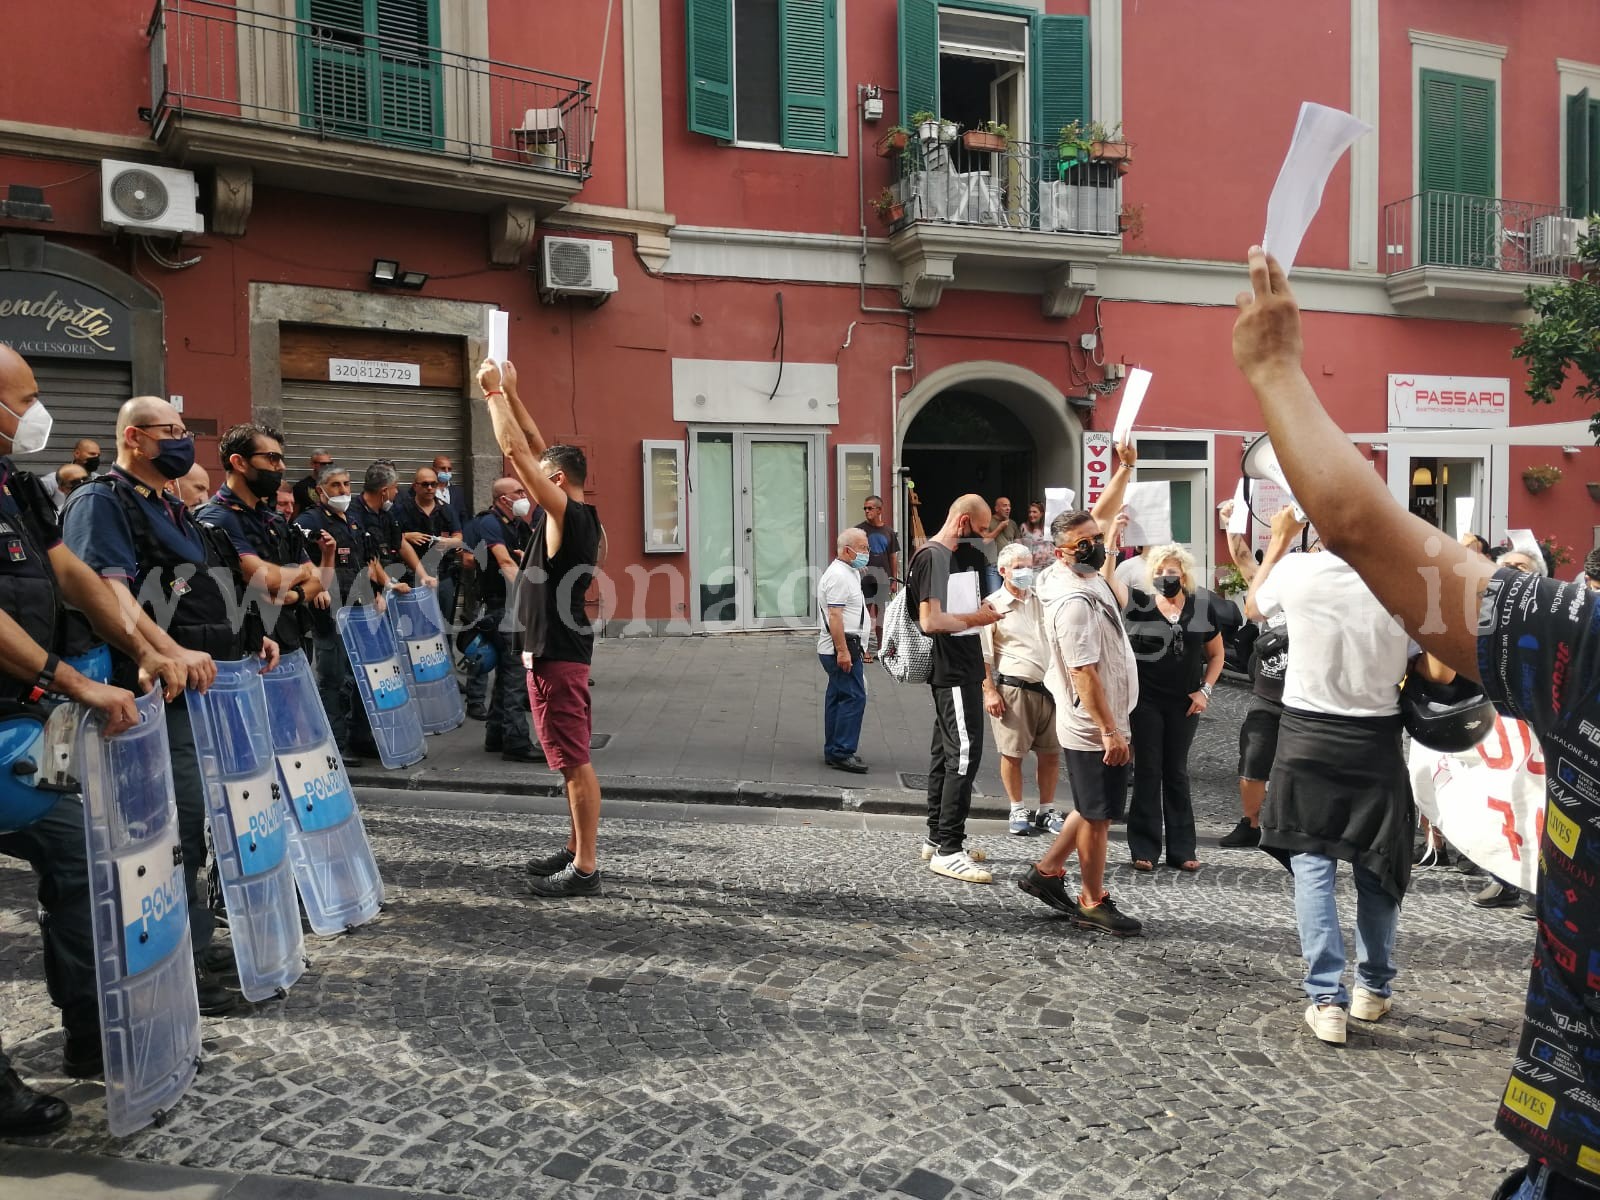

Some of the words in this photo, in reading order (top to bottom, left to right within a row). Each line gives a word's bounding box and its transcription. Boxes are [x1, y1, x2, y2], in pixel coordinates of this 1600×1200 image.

[19, 341, 96, 355] ACCESSORIES
[1416, 390, 1505, 406] PASSARO
[1550, 811, 1573, 844] LIVES
[1511, 1087, 1547, 1115] LIVES
